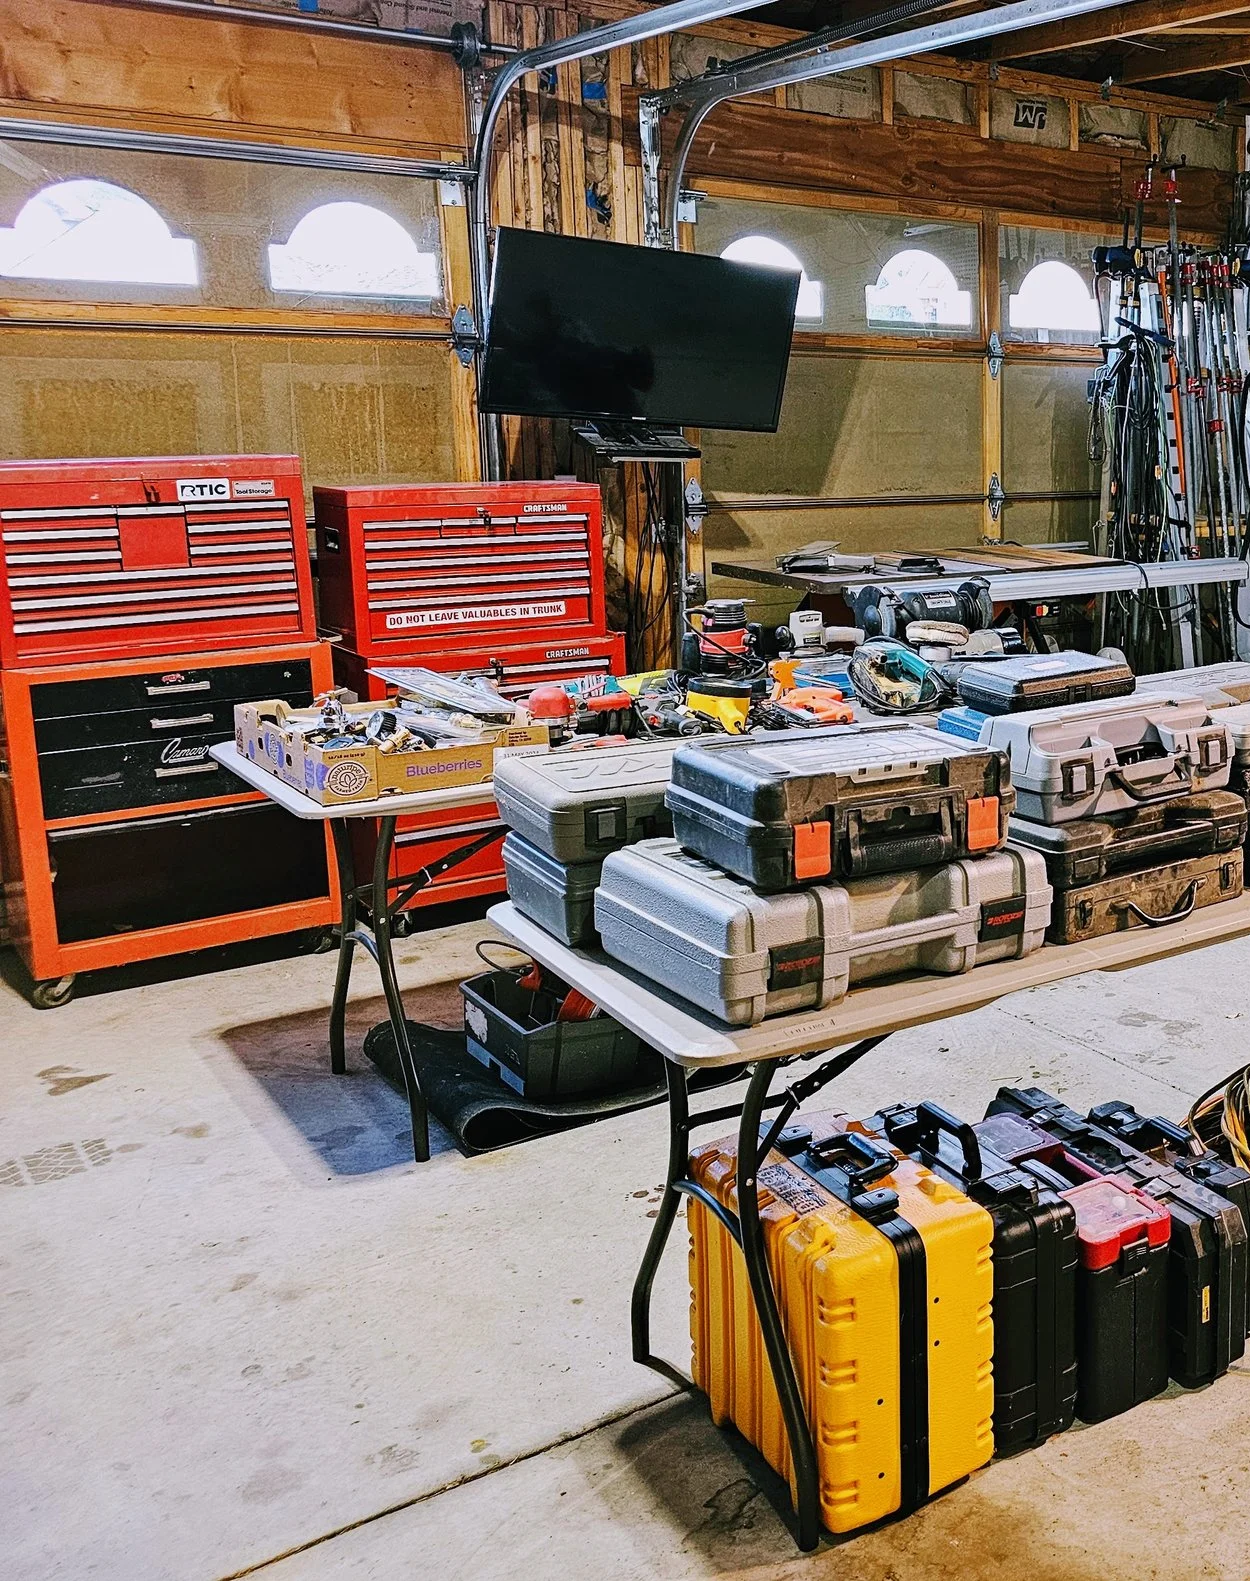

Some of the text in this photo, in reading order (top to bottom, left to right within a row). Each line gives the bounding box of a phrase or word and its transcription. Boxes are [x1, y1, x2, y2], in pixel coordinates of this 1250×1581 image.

[1015, 102, 1048, 130] JM
[180, 484, 227, 497] RTIC
[248, 488, 273, 496] Storage
[523, 504, 568, 513] CRAFTSMAN
[389, 604, 563, 626] DO NOT LEAVE VALUABLES IN TRUNK
[545, 648, 589, 659] CRAFTSMAN
[160, 738, 210, 763] Camaro
[332, 764, 362, 780] naturipe
[405, 758, 483, 778] Blueberries
